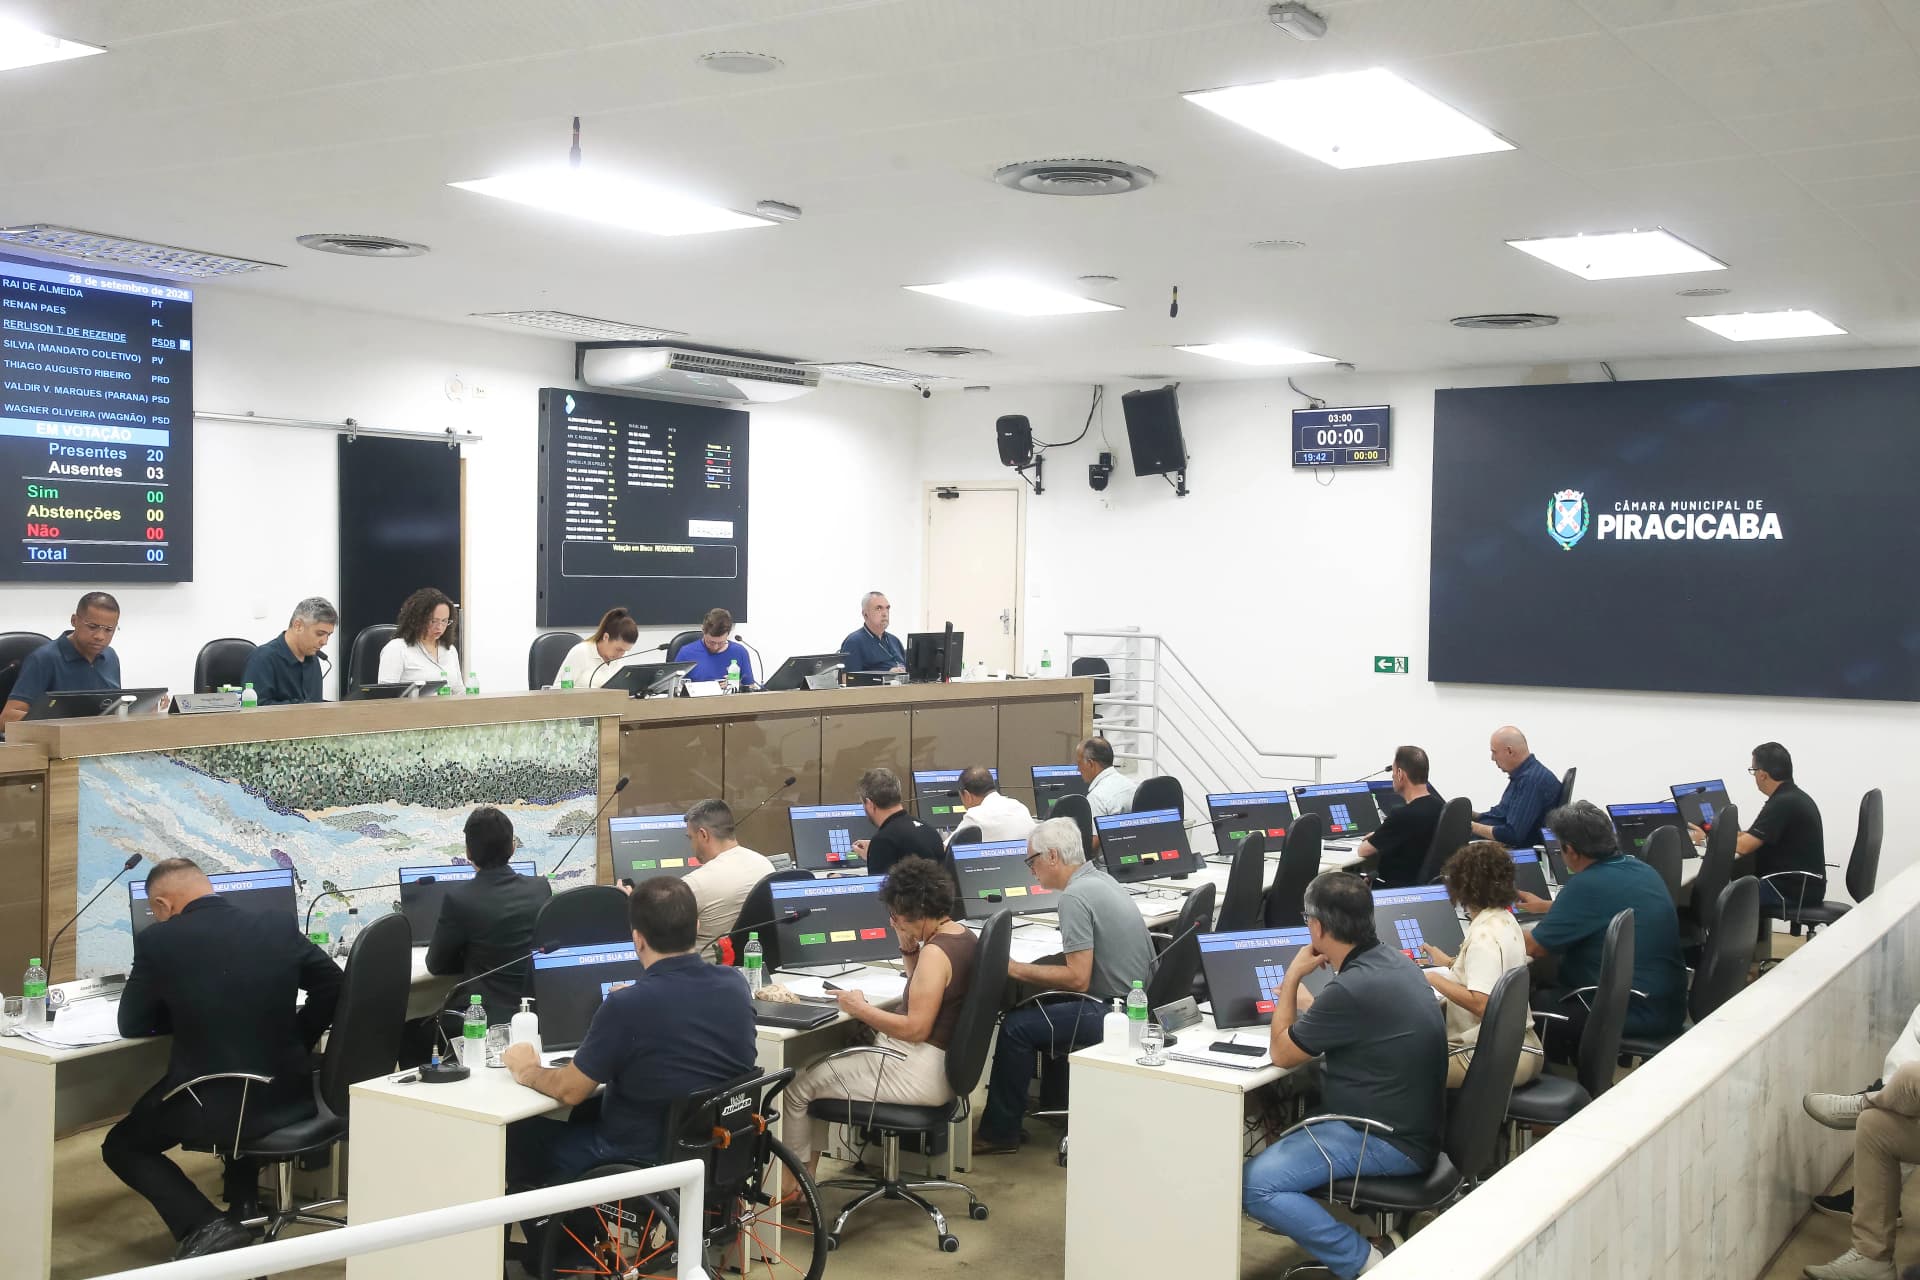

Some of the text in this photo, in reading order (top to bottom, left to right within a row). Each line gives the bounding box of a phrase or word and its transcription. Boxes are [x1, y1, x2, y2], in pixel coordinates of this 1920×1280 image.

[3, 279, 83, 298] RAI DE ALMEIDA
[84, 277, 98, 287] de
[100, 279, 149, 293] setembro
[152, 287, 164, 296] de
[3, 300, 67, 315] RENAN PAES
[152, 300, 164, 309] PT
[4, 319, 54, 333] RERLISON
[67, 327, 80, 337] DE
[83, 329, 127, 342] REZENDE
[152, 319, 164, 328] PL
[152, 338, 176, 348] PSDB
[4, 340, 142, 364] SILVIA (MANDATO COLETIVO)
[152, 356, 164, 365] PV
[4, 360, 132, 380] THIAGO AUGUSTO RIBEIRO
[152, 375, 170, 384] PRD
[5, 382, 41, 393] VALDIR
[54, 387, 103, 398] MARQUES
[152, 395, 170, 405] PSD
[5, 404, 147, 425] WAGNER OLIVEIRA (WAGNÃO)
[152, 416, 170, 425] PSD
[1328, 414, 1352, 423] 03:00
[37, 423, 132, 442] EM VOTAÇÃO
[1317, 429, 1364, 445] 00:00
[50, 443, 164, 462] Presentes 20
[1304, 453, 1327, 461] 19:42
[1354, 451, 1378, 460] 00:00
[49, 461, 164, 480] Ausentes 03
[27, 485, 164, 503] Sim 00
[27, 505, 164, 522] Abstenções 00
[1615, 500, 1764, 511] CÂMARA MUNICIPAL DE
[27, 524, 164, 540] Não 00
[1597, 513, 1784, 540] PIRACICABA
[28, 547, 164, 562] Total 00
